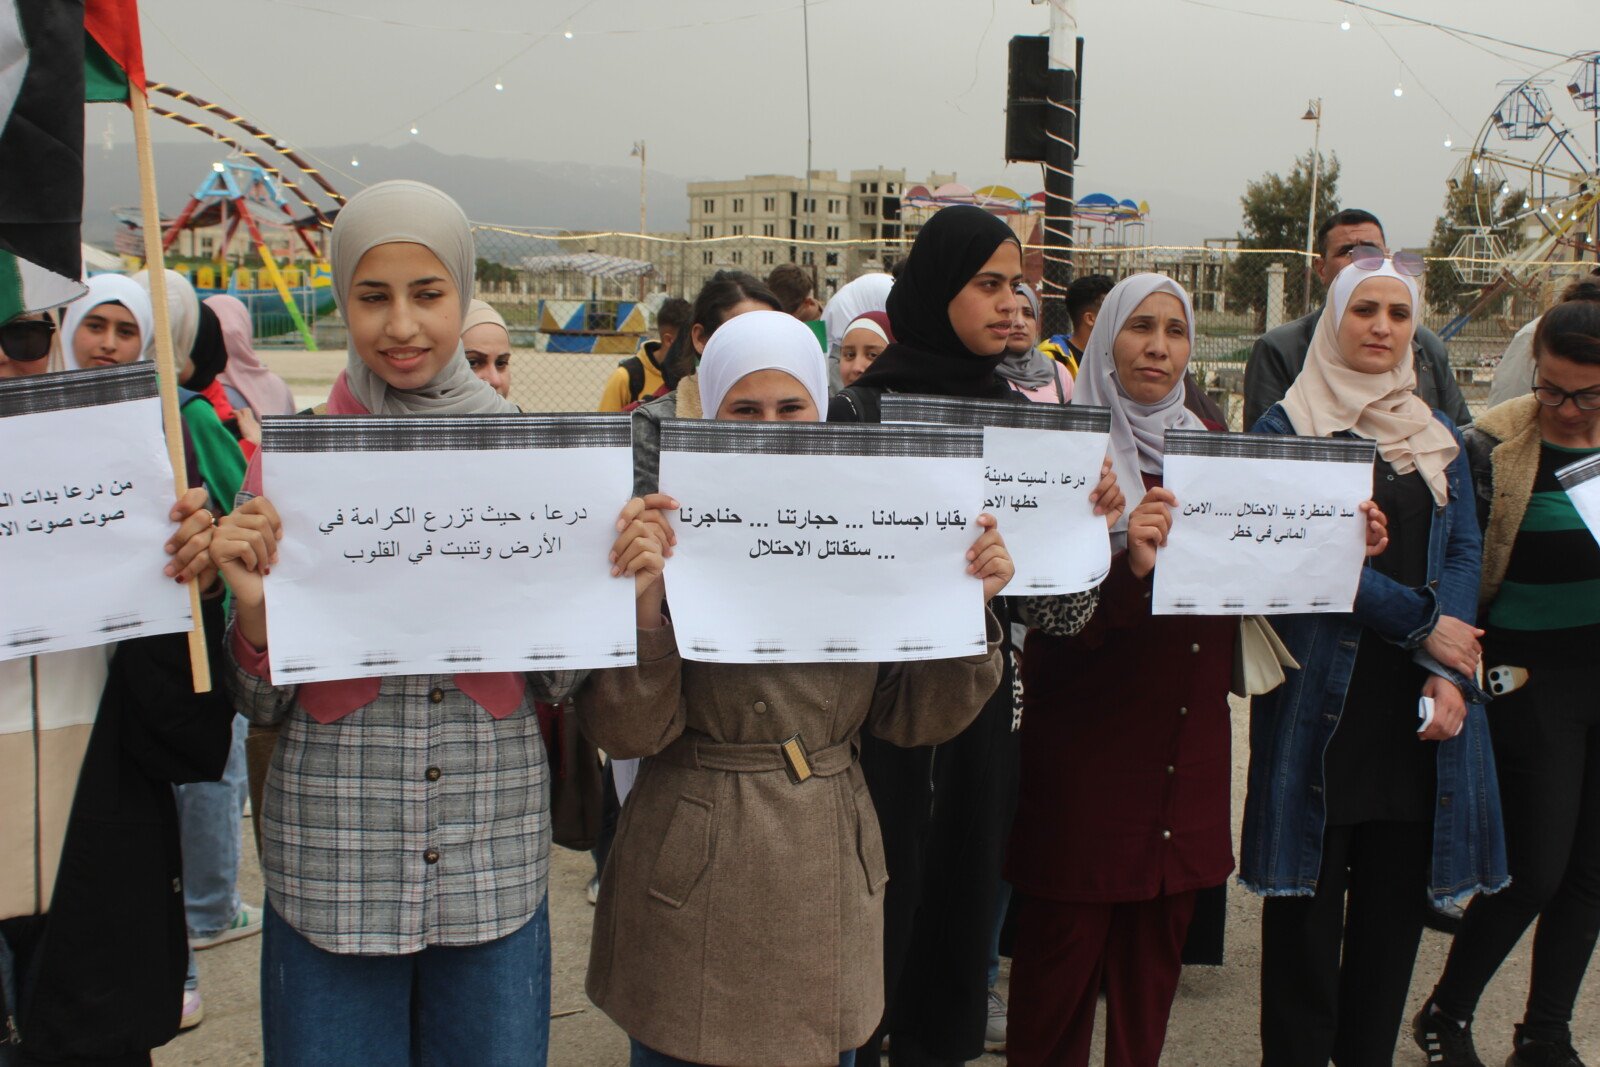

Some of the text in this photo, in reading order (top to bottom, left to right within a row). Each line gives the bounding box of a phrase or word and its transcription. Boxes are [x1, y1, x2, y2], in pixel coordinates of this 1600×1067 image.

[984, 466, 1013, 486] مدينة
[1060, 472, 1086, 489] درعا
[20, 488, 59, 505] بدات
[63, 483, 104, 500] درعا
[110, 480, 133, 496] من
[1010, 494, 1038, 512] خطها
[1183, 501, 1212, 516] الامن
[1236, 502, 1278, 517] الاحتلال
[26, 516, 73, 534] صوت
[79, 508, 125, 527] صوت
[318, 508, 344, 535] في
[350, 506, 416, 531] الكرامة
[423, 507, 474, 532] تزرع
[480, 505, 522, 526] حيث
[544, 504, 588, 526] درعا
[679, 507, 743, 528] حناجرنا
[777, 509, 838, 530] حجارتنا
[872, 510, 929, 531] اجسادنا
[936, 509, 967, 531] بقايا
[1228, 524, 1253, 541] خطر
[1255, 524, 1272, 545] في
[343, 532, 562, 565] الأرض وتنبت في القلوب
[749, 538, 811, 559] الاحتلال
[817, 539, 871, 560] ستقاتل
